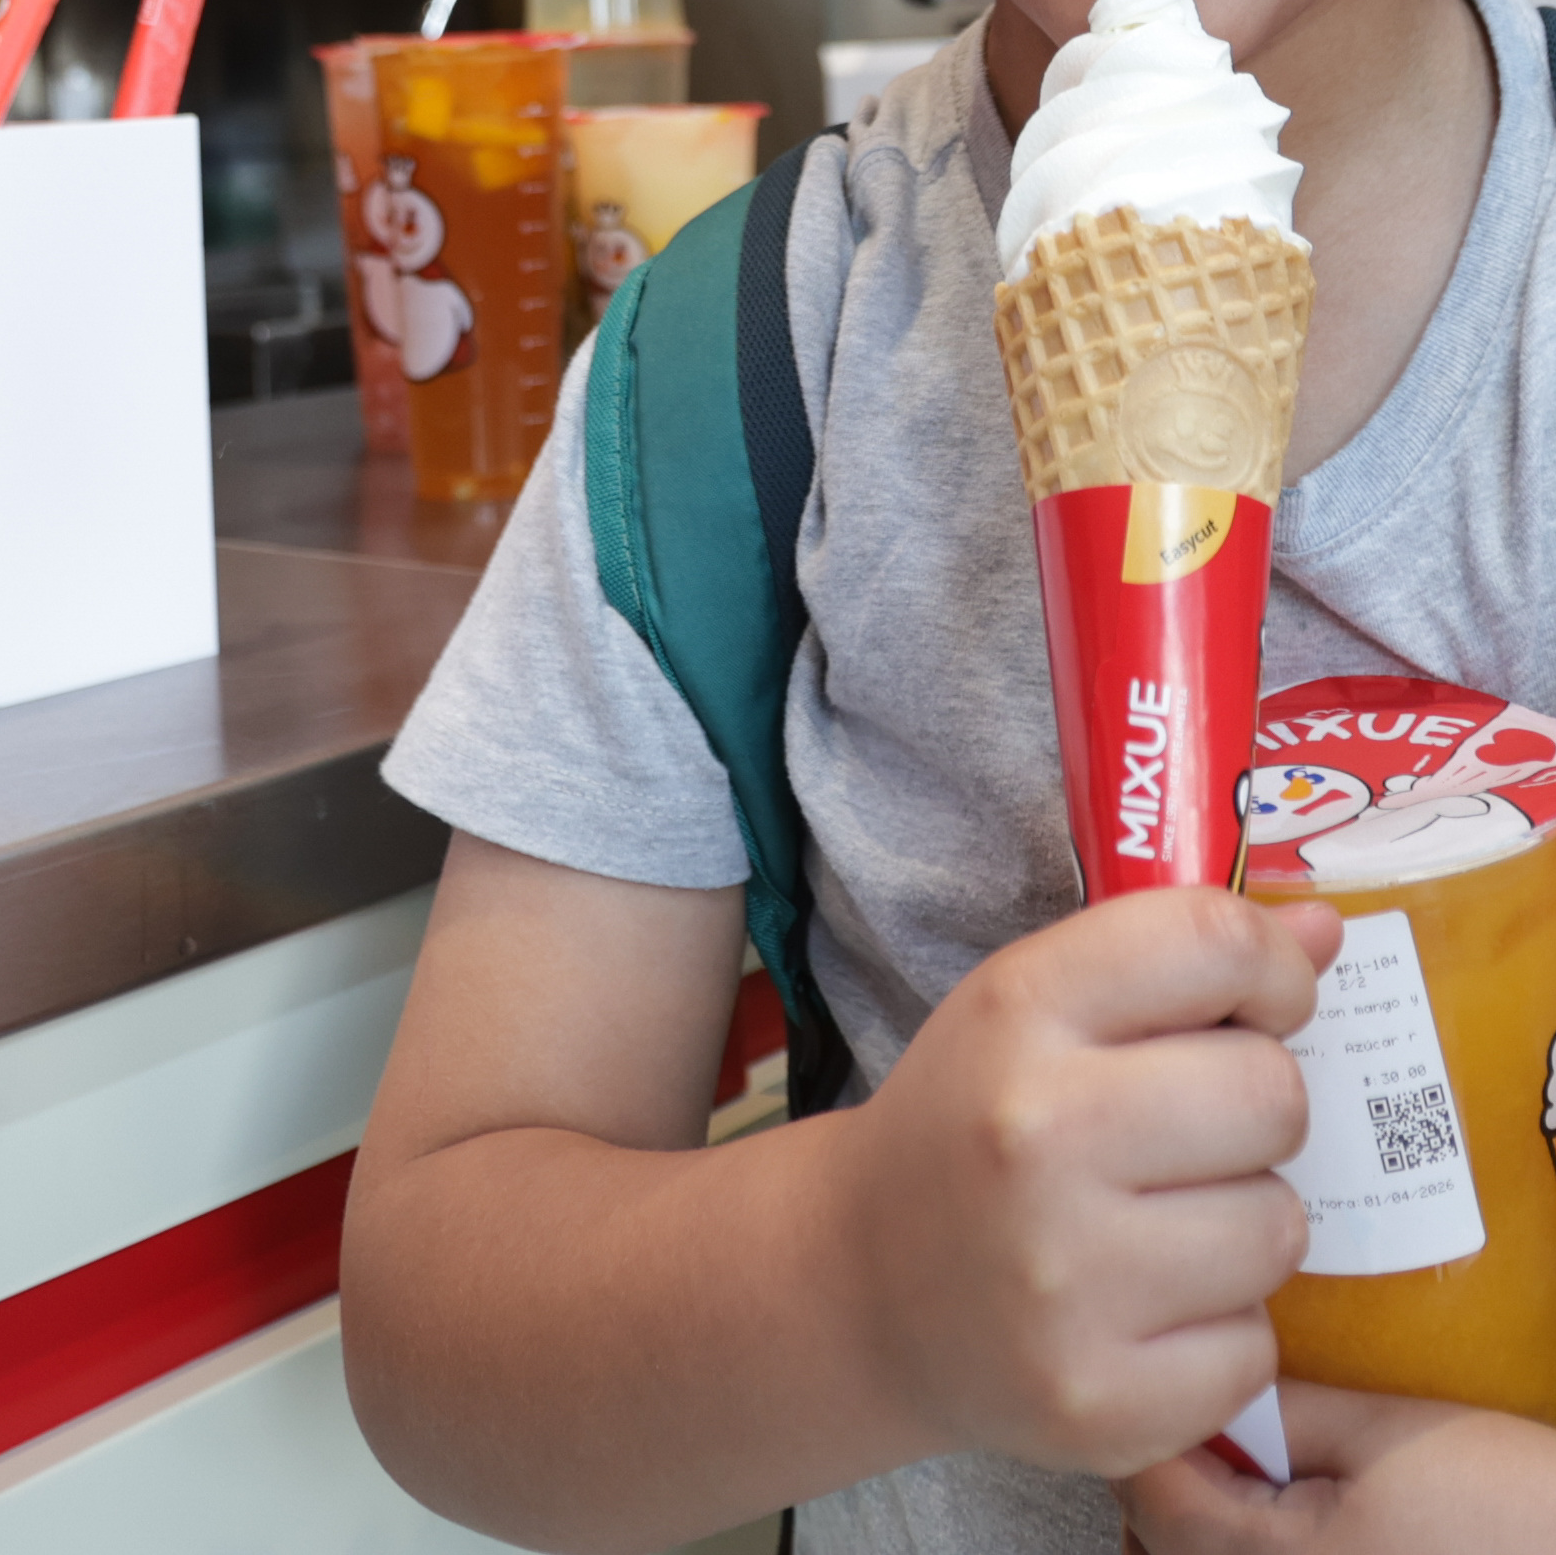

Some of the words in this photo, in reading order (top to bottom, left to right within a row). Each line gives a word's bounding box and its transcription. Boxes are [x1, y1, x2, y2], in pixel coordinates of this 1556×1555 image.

[1159, 519, 1219, 566] Easycut
[1116, 677, 1172, 861] MIXUE
[1164, 795, 1178, 822] 1997
[1161, 823, 1175, 862] SINCE
[1335, 954, 1400, 978] #P1-104
[1338, 976, 1367, 992] 2/2
[1318, 1008, 1346, 1021] con
[1353, 998, 1402, 1017] mango
[1345, 1036, 1400, 1055] Azúcar
